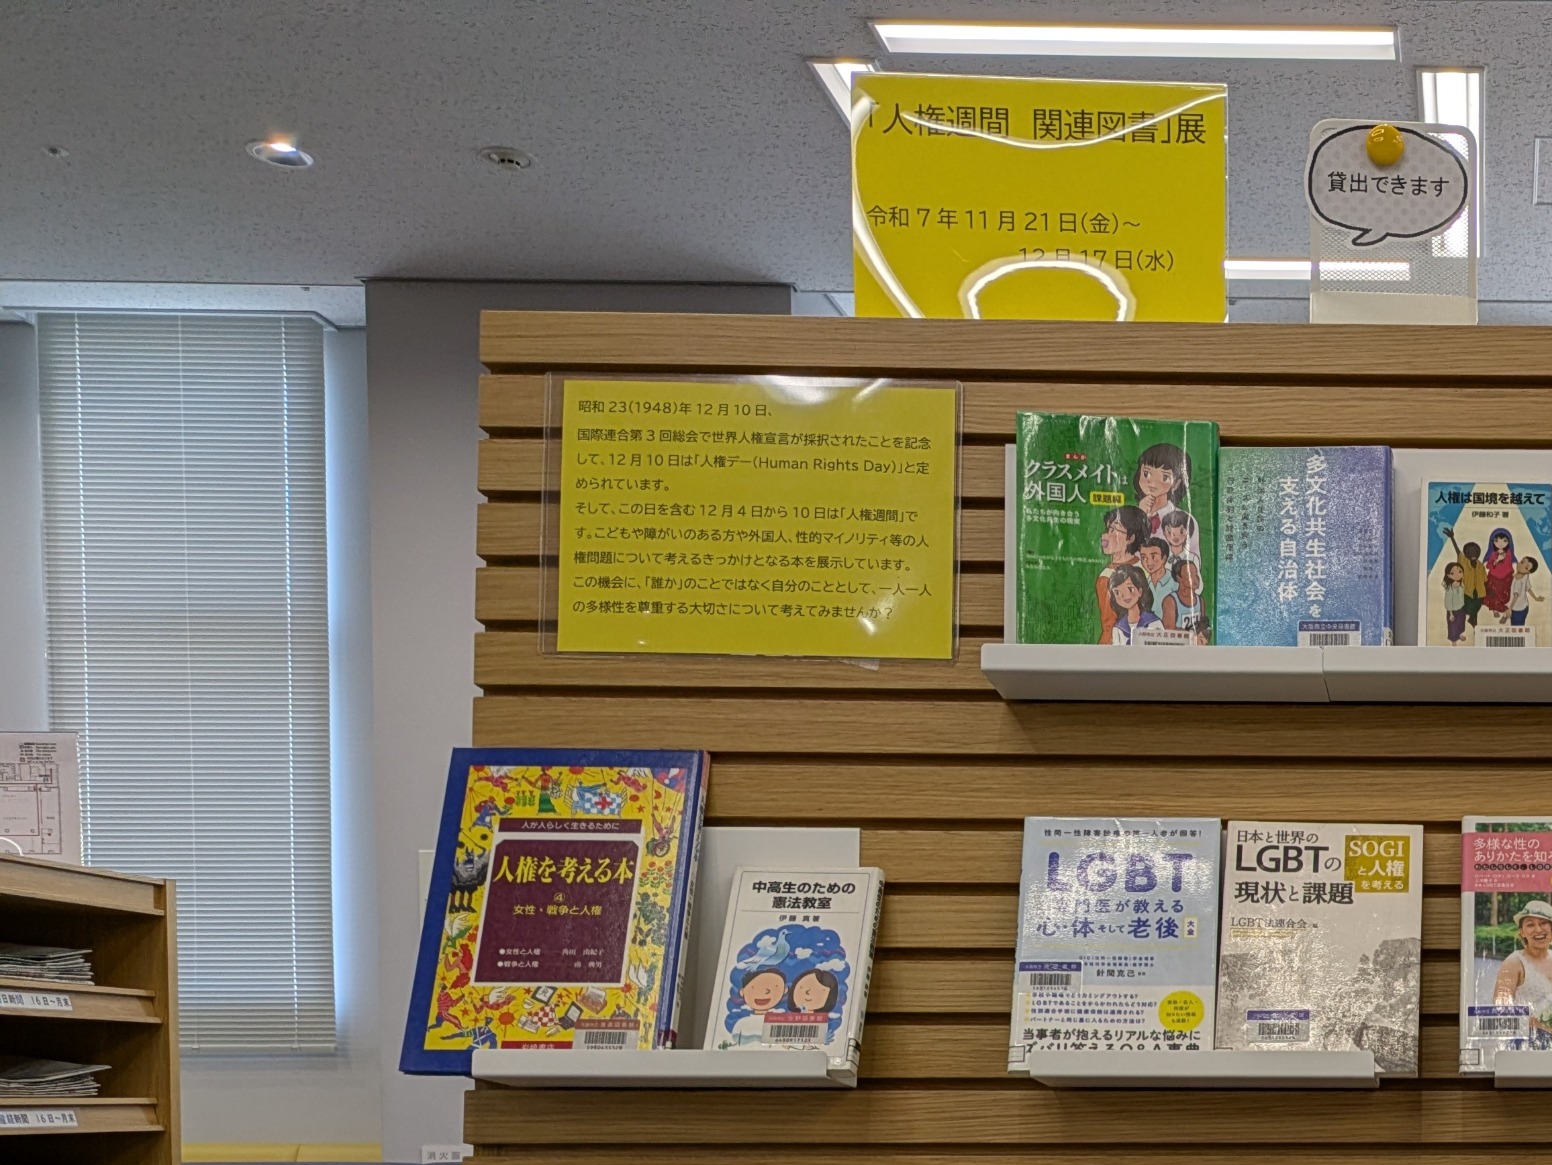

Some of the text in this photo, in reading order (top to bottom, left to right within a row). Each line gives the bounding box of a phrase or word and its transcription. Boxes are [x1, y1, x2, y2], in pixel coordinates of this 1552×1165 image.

[1032, 109, 1207, 146] 関連図書」展
[1327, 171, 1449, 197] 貸出できます
[577, 428, 931, 451] 国際連合第3回総会で世界人権宣言が採択されたことを記念
[813, 458, 860, 474] Rights
[1027, 459, 1128, 486] クラスメイトは
[575, 477, 671, 492] められています。
[1026, 483, 1087, 503] 外国人
[1435, 490, 1546, 505] 人権は国境を越えて
[575, 501, 918, 523] そして、この日を含む12月4日から10日は「人権週間」で
[574, 526, 930, 548] す。こどもや障がいのある方や外国人、性的マイノリティ等の人
[1277, 475, 1300, 603] 支える自治体
[1305, 454, 1328, 618] 多文化共生社会を
[573, 550, 912, 573] 権問題について考えるきっかけとなる本を展示しています。
[573, 575, 932, 597] この機会に、「誰か」のことではなく自分のこととして、一人一人
[1301, 623, 1356, 631] 大阪市立中央図書館
[521, 822, 620, 831] 人が人らしく生きるために
[1237, 830, 1319, 845] 日本と世界の
[1474, 837, 1540, 851] 多様な性の
[1235, 840, 1405, 874] LGBTの SOGI
[493, 855, 635, 885] 人権を考える本
[1047, 851, 1194, 893] LGBT
[1358, 859, 1405, 877] と人権
[752, 880, 856, 895] 中高生のための
[1234, 881, 1355, 905] 現状と課題
[1361, 880, 1404, 890] を考える
[513, 905, 602, 916] 女性・戦争と人権
[772, 896, 831, 910] 憲法教室
[779, 914, 797, 923] 伊藤
[1036, 917, 1179, 939] 心・体そして老後
[1096, 969, 1136, 978] 針間克己
[1023, 1028, 1201, 1042] 当事者が抱えるリアルな悩みに
